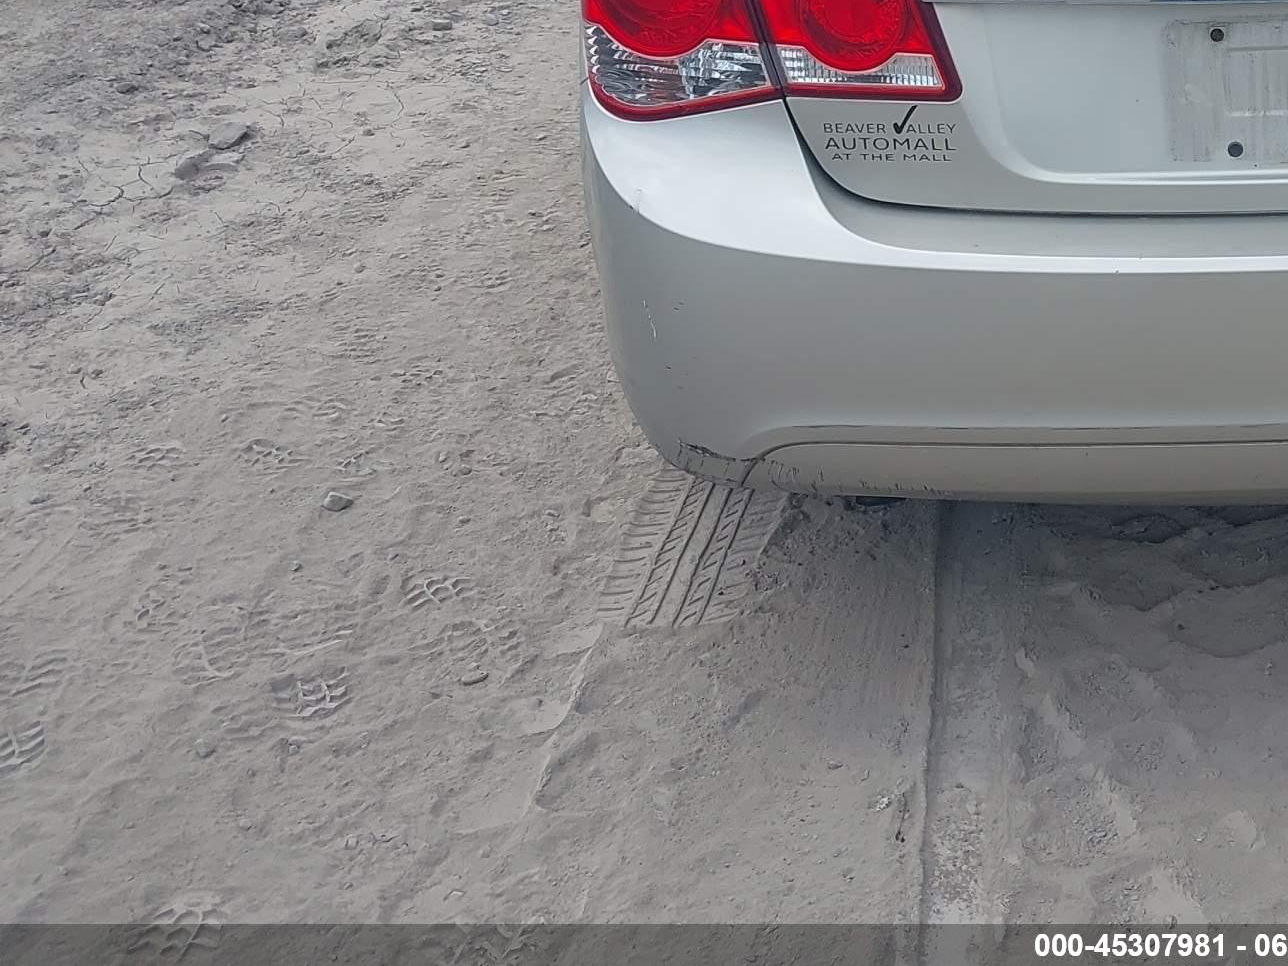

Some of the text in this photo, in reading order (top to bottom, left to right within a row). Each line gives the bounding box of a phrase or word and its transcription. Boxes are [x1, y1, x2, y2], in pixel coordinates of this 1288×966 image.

[823, 122, 887, 134] BEAVER
[824, 137, 957, 151] AUTOMALL
[831, 153, 953, 162] AT THE MALL
